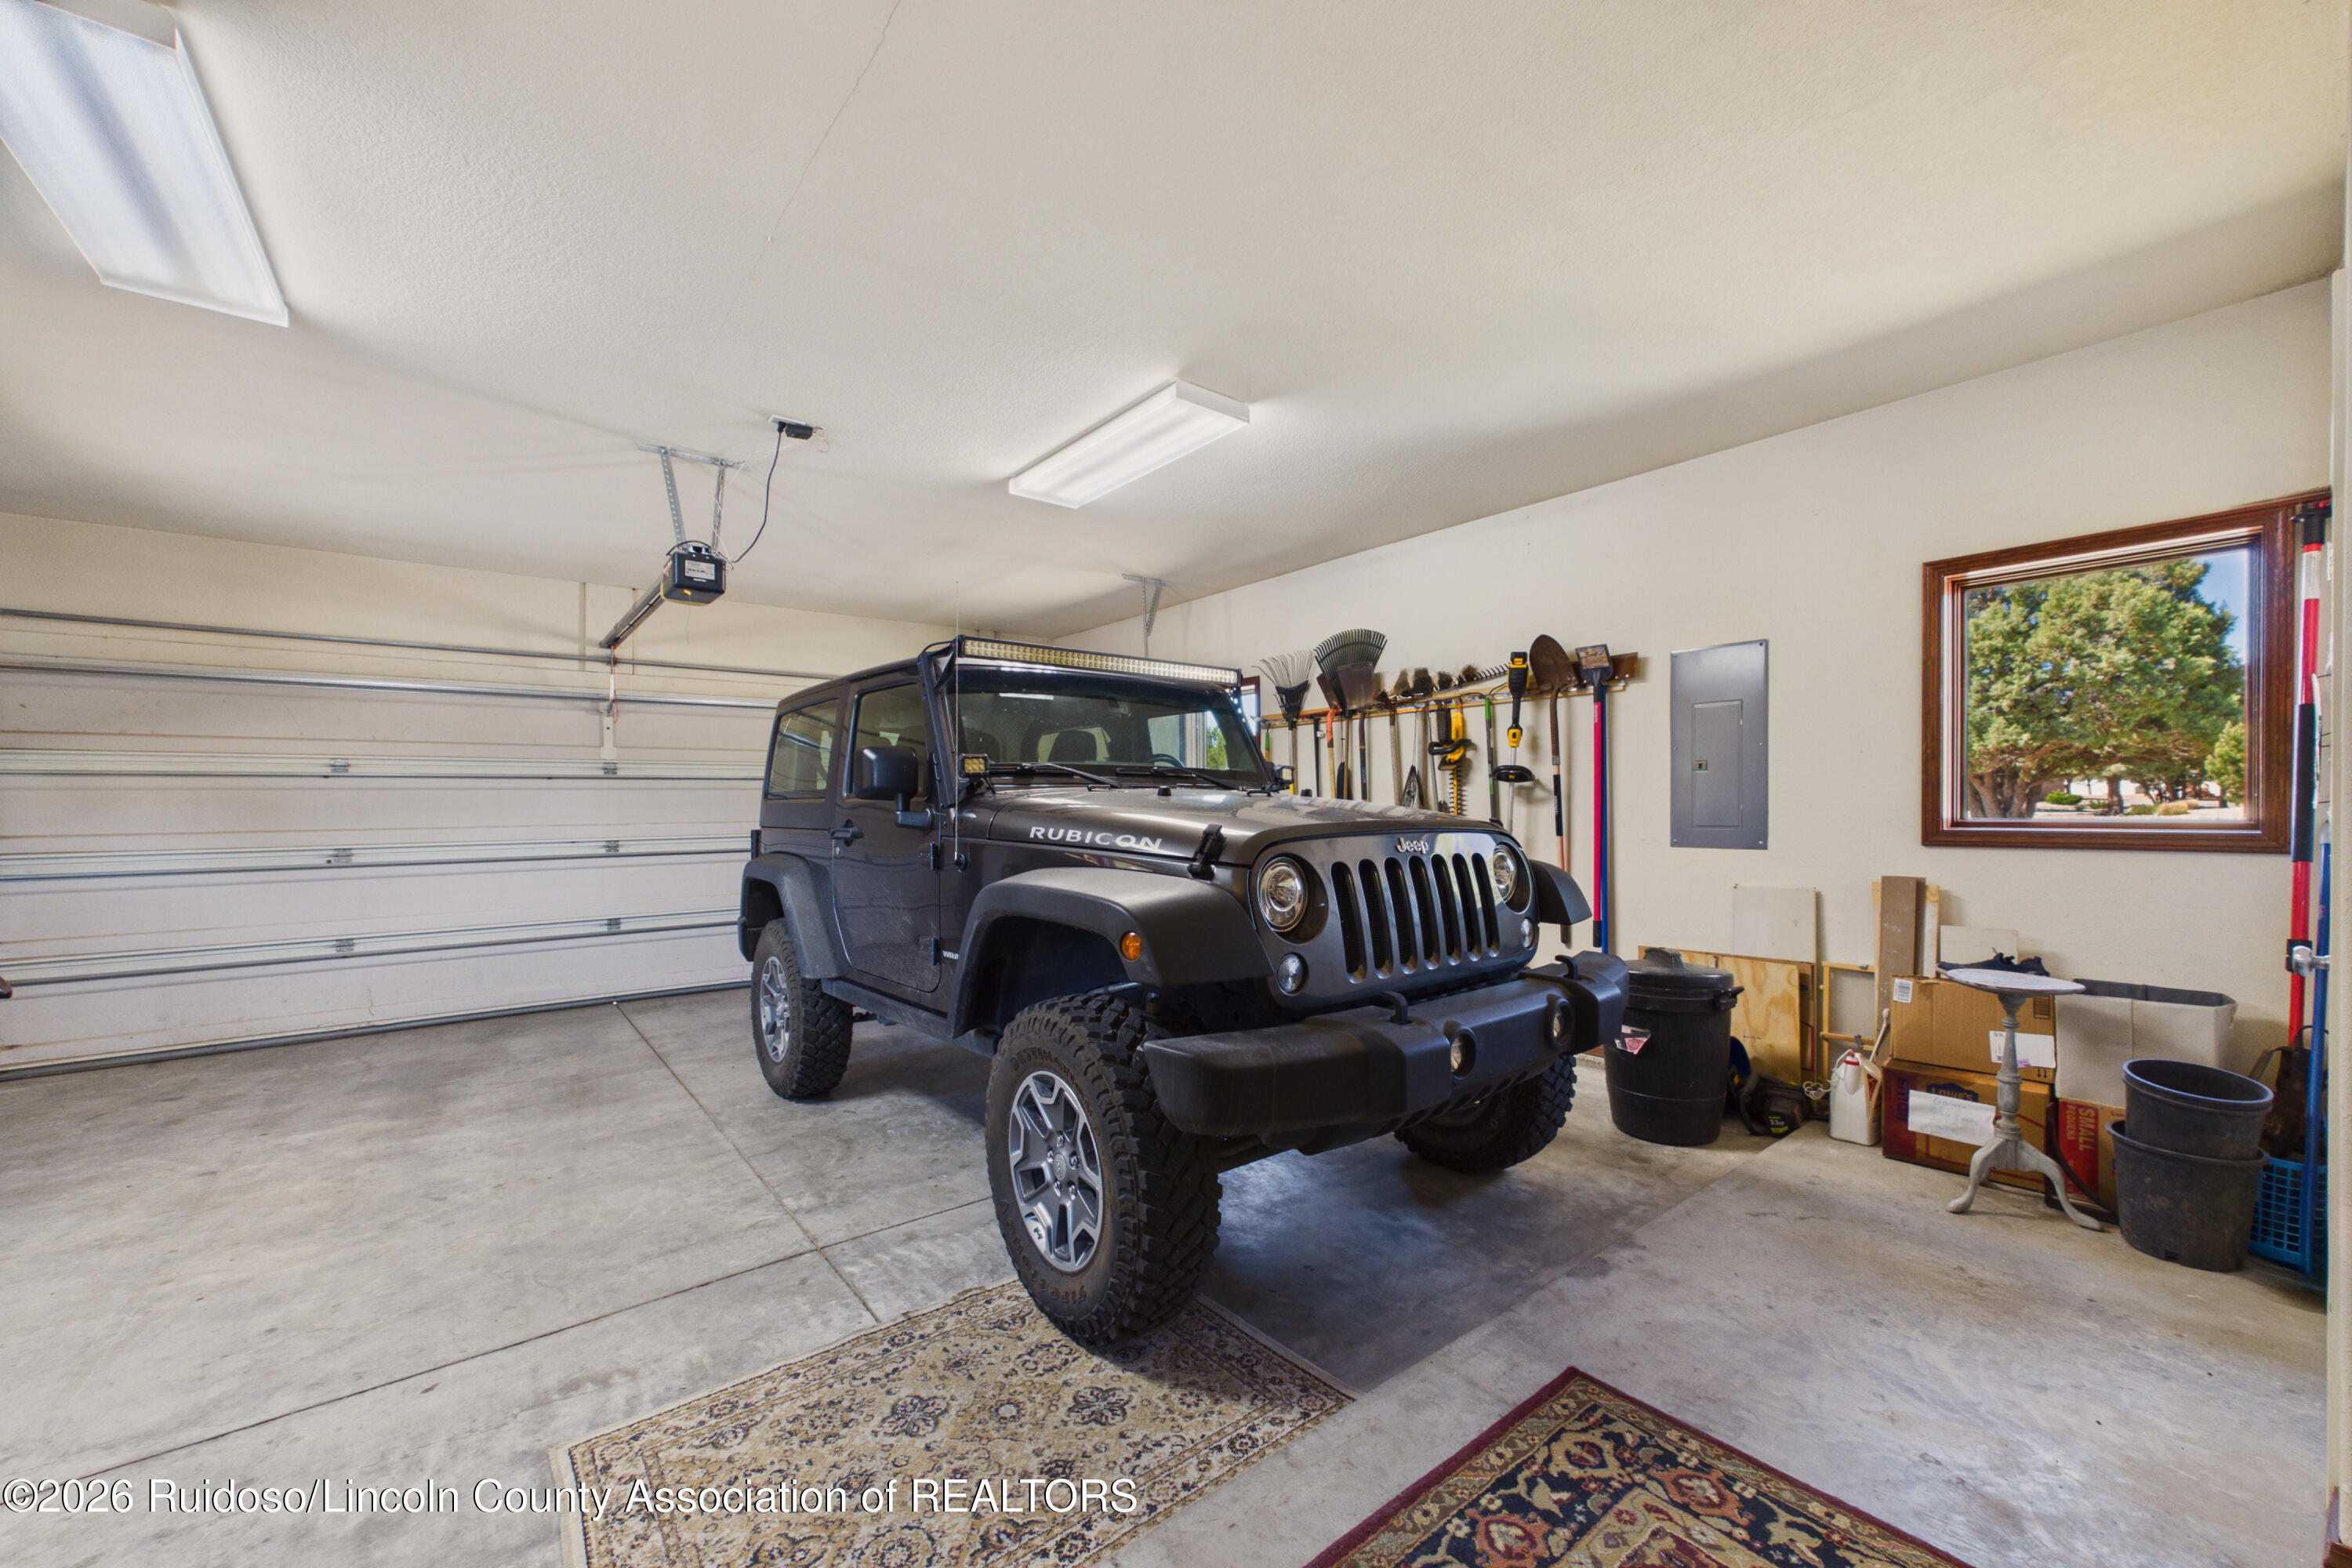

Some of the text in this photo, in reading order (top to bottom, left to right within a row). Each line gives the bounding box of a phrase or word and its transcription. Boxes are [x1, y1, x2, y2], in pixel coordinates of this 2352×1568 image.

[1029, 826, 1163, 851] RUBICON
[1395, 837, 1428, 855] Jeep
[2078, 1108, 2095, 1151] SMALL
